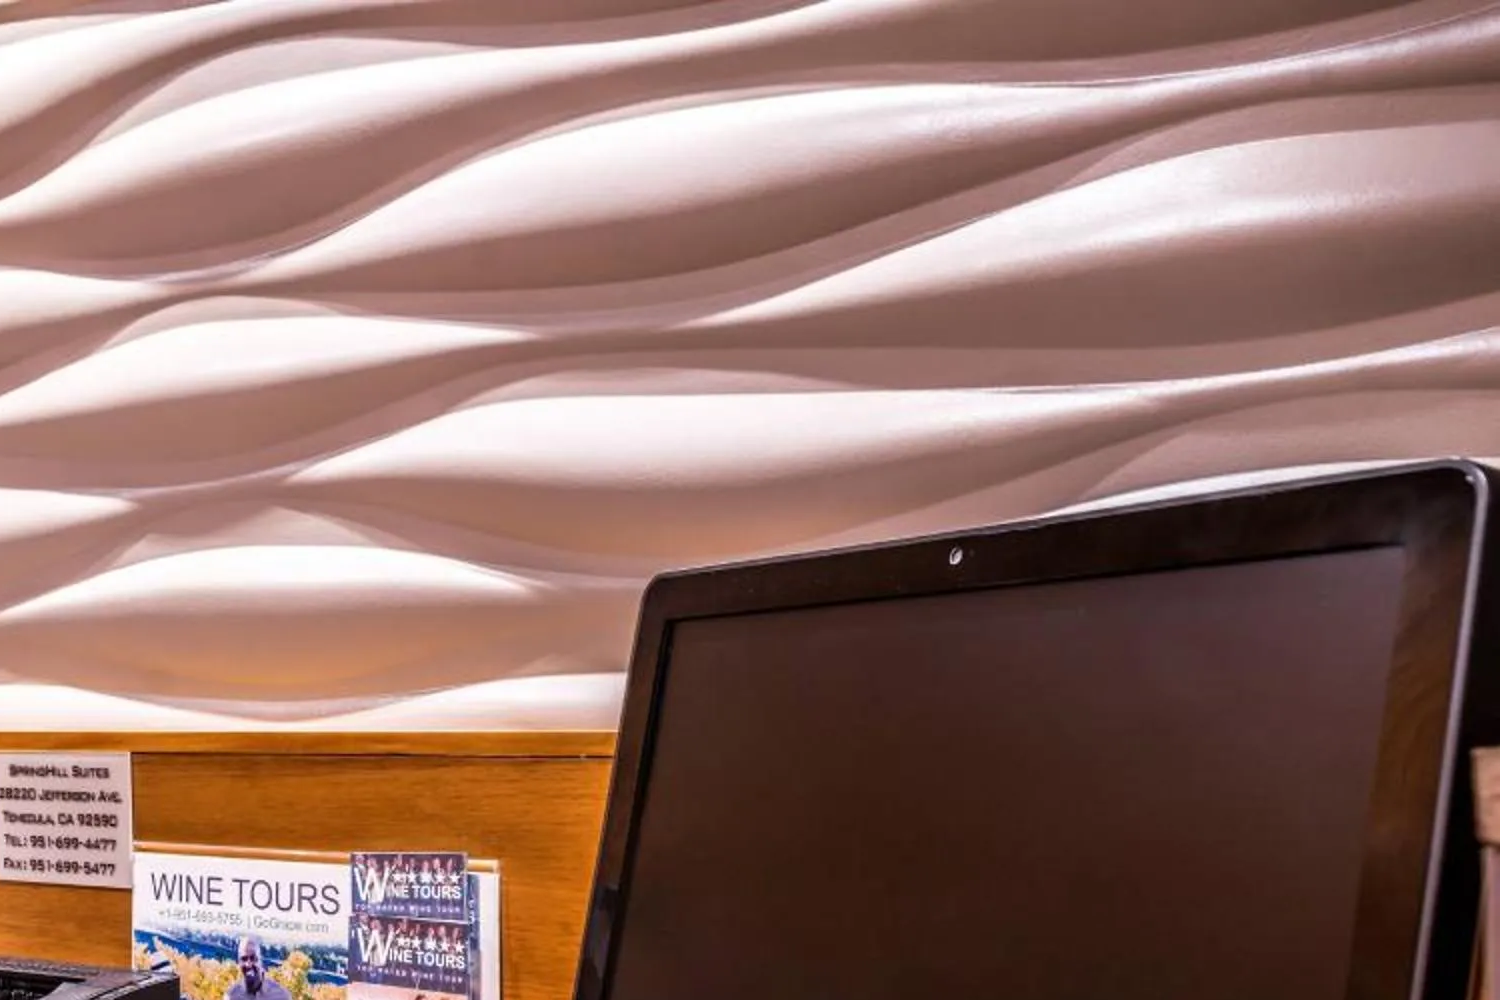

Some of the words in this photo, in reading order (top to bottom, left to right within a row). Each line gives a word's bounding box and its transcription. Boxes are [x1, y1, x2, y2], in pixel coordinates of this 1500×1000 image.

[57, 812, 74, 826] CA
[77, 813, 118, 828] 92590
[150, 872, 224, 906] WINE
[232, 879, 341, 915] TOURS
[411, 885, 462, 900] TOURS
[415, 951, 465, 969] TOURS
